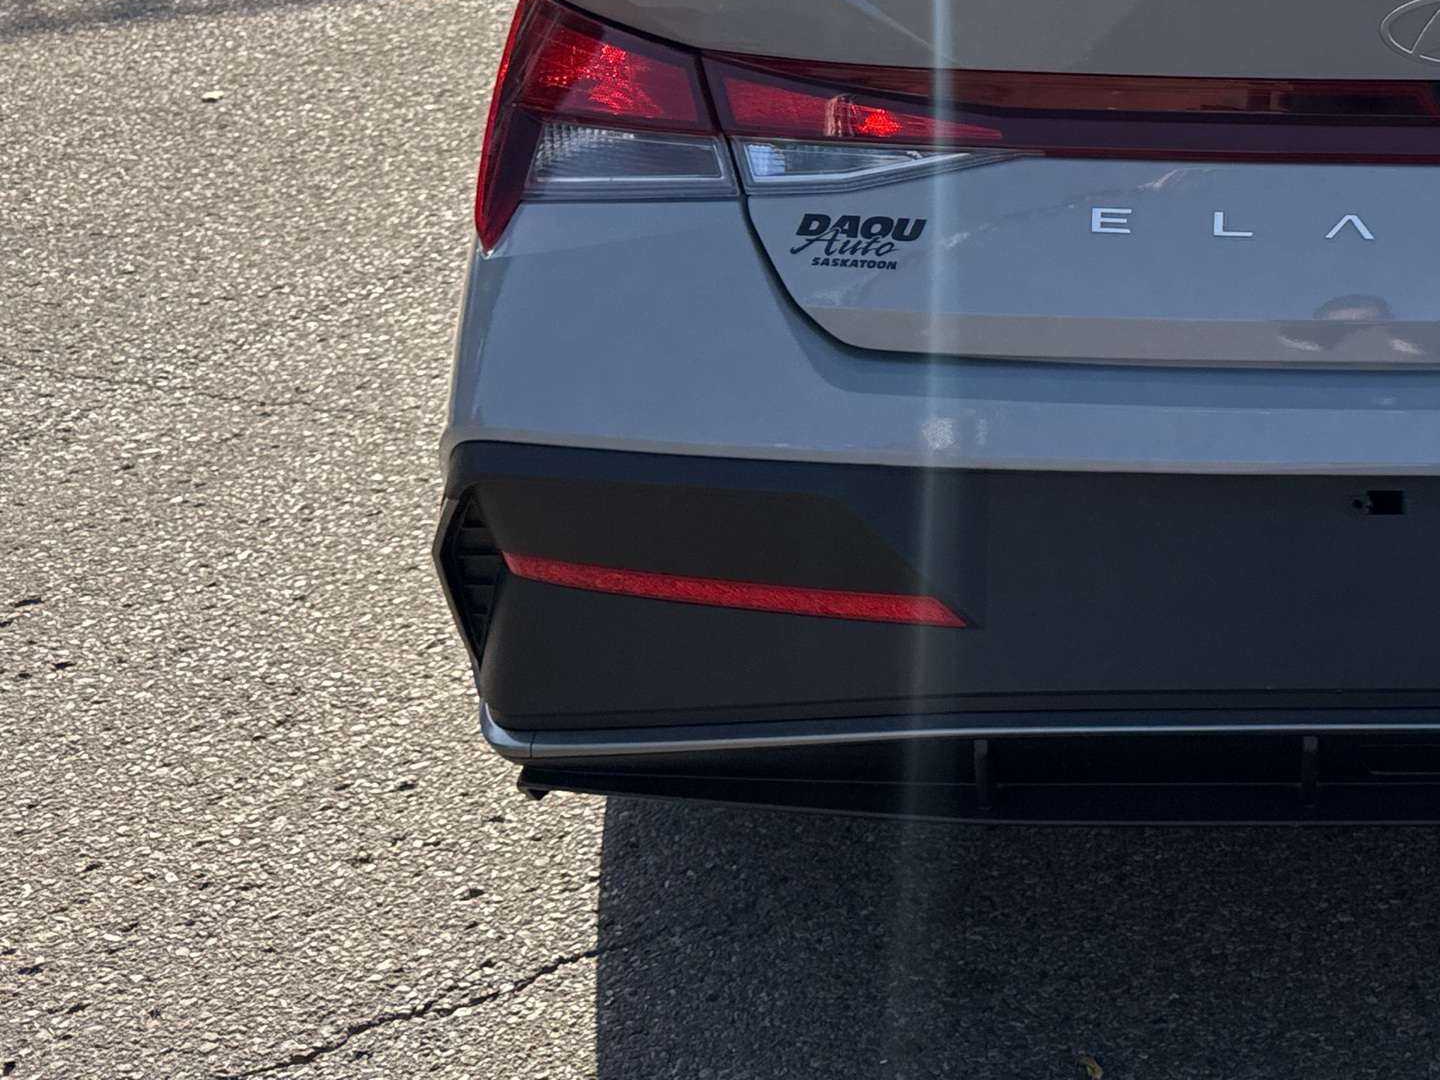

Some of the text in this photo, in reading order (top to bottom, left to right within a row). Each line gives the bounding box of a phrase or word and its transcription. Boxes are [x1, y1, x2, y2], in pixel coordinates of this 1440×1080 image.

[795, 213, 928, 242] DAOU
[790, 228, 900, 257] Auto
[811, 256, 898, 270] SASKATOON
